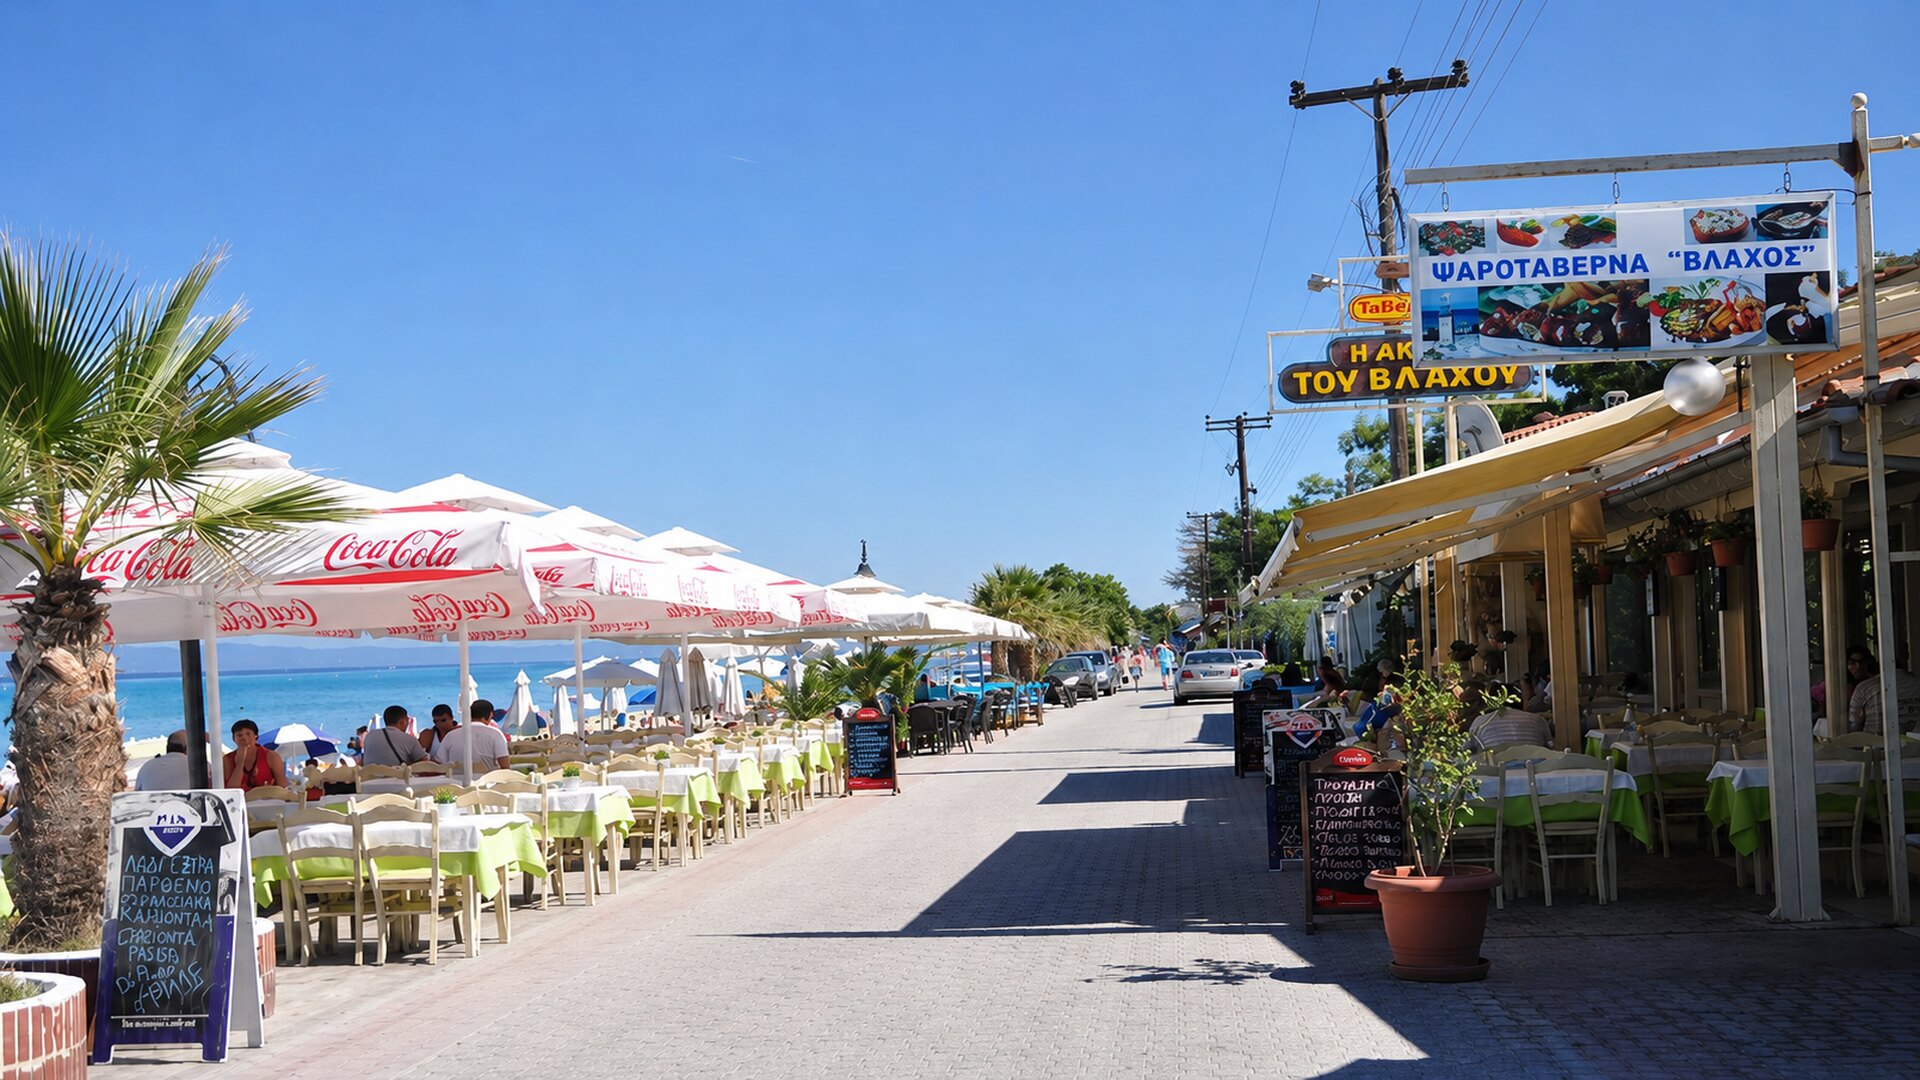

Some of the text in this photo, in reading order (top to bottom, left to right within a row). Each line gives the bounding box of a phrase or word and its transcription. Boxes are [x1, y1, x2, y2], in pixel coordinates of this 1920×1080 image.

[1432, 253, 1649, 282] ΨΑΡΟΤΑΒΕΡΝΑ
[1293, 365, 1518, 395] ΤΟΥ ΒΛΑΧΟΥ
[323, 529, 465, 571] Coca-Cola
